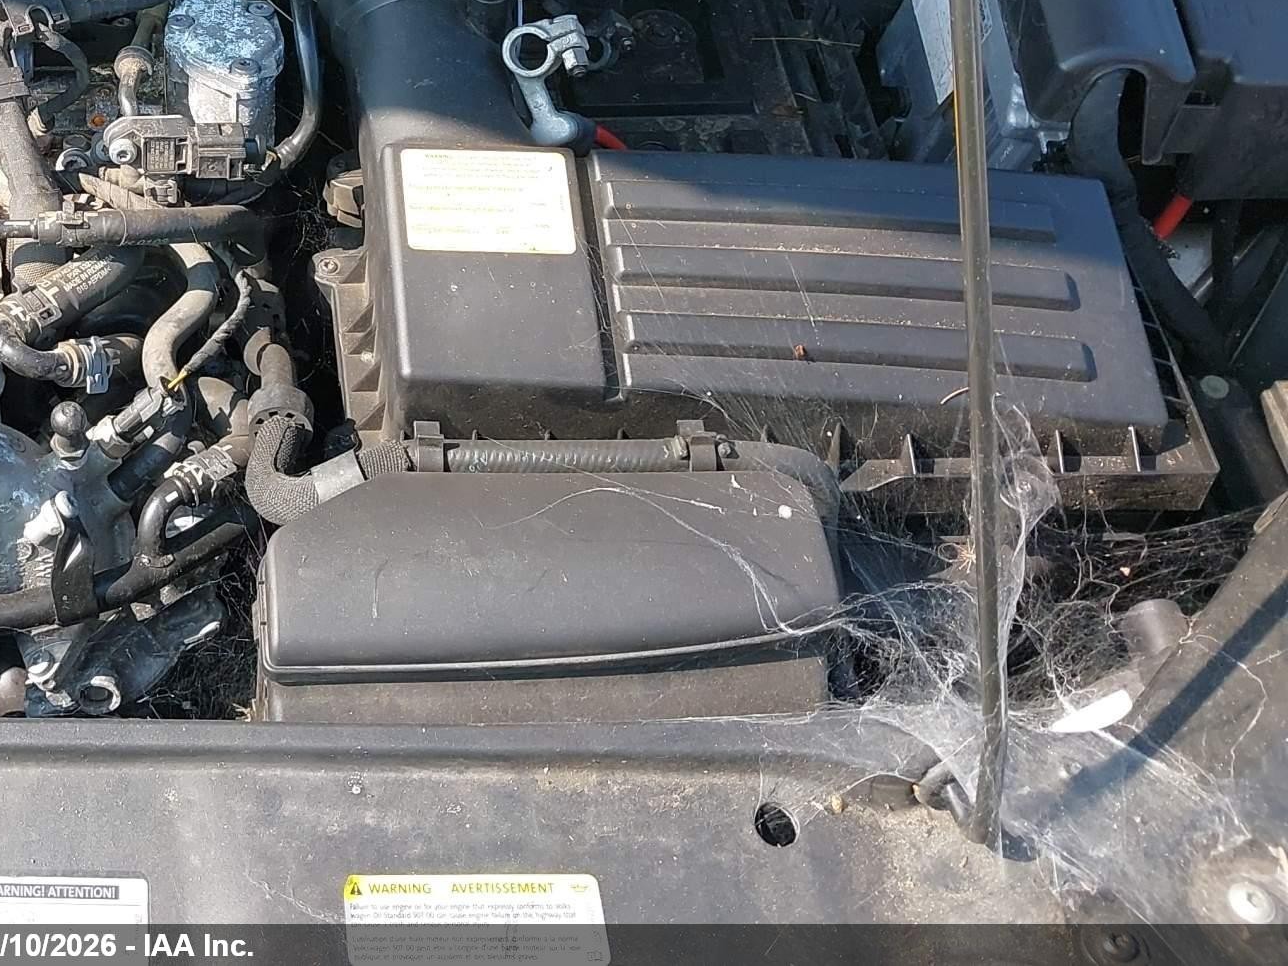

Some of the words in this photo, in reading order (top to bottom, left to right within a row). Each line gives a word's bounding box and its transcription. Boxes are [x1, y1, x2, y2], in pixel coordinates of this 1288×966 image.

[47, 885, 116, 900] ATTENTION!
[369, 882, 432, 894] WARNING
[451, 882, 555, 894] AVERTISSEMENT
